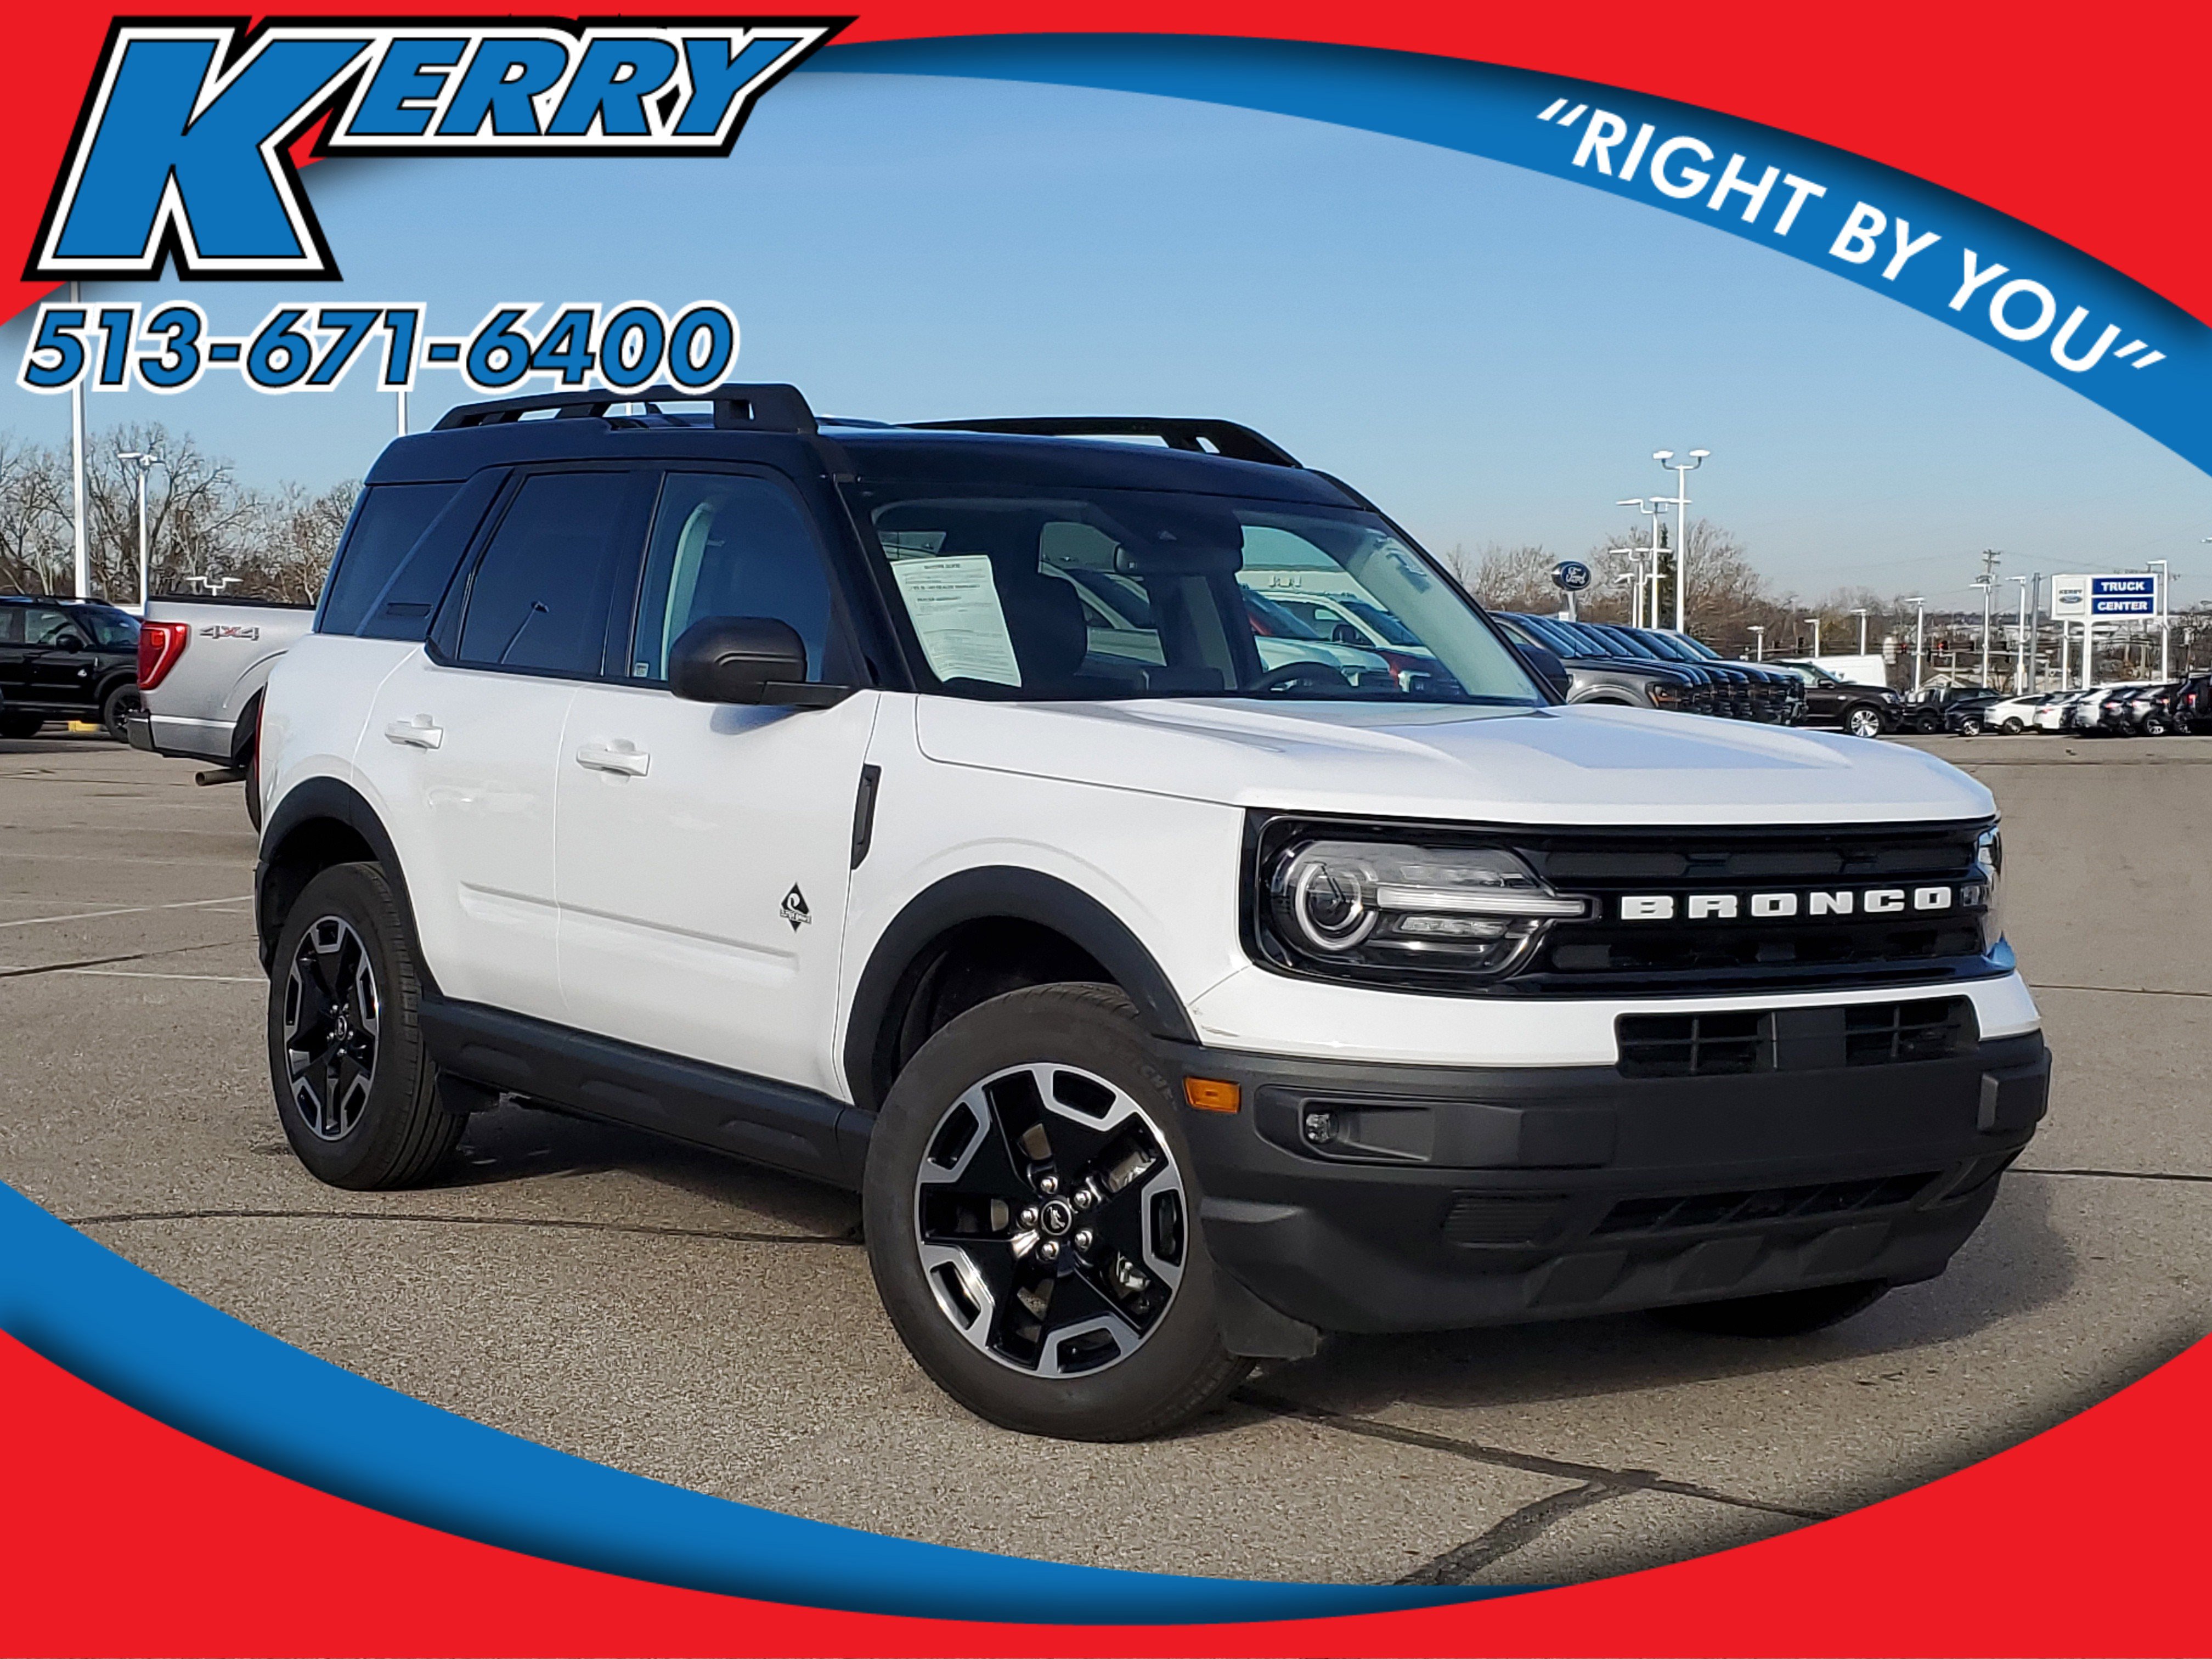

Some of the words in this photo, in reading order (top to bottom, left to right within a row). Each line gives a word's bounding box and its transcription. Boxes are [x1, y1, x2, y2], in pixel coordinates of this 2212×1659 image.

[1566, 567, 1587, 585] Ford
[2101, 582, 2145, 591] TRUCK
[2097, 601, 2147, 611] CENTER
[1621, 887, 1951, 920] BRONCO
